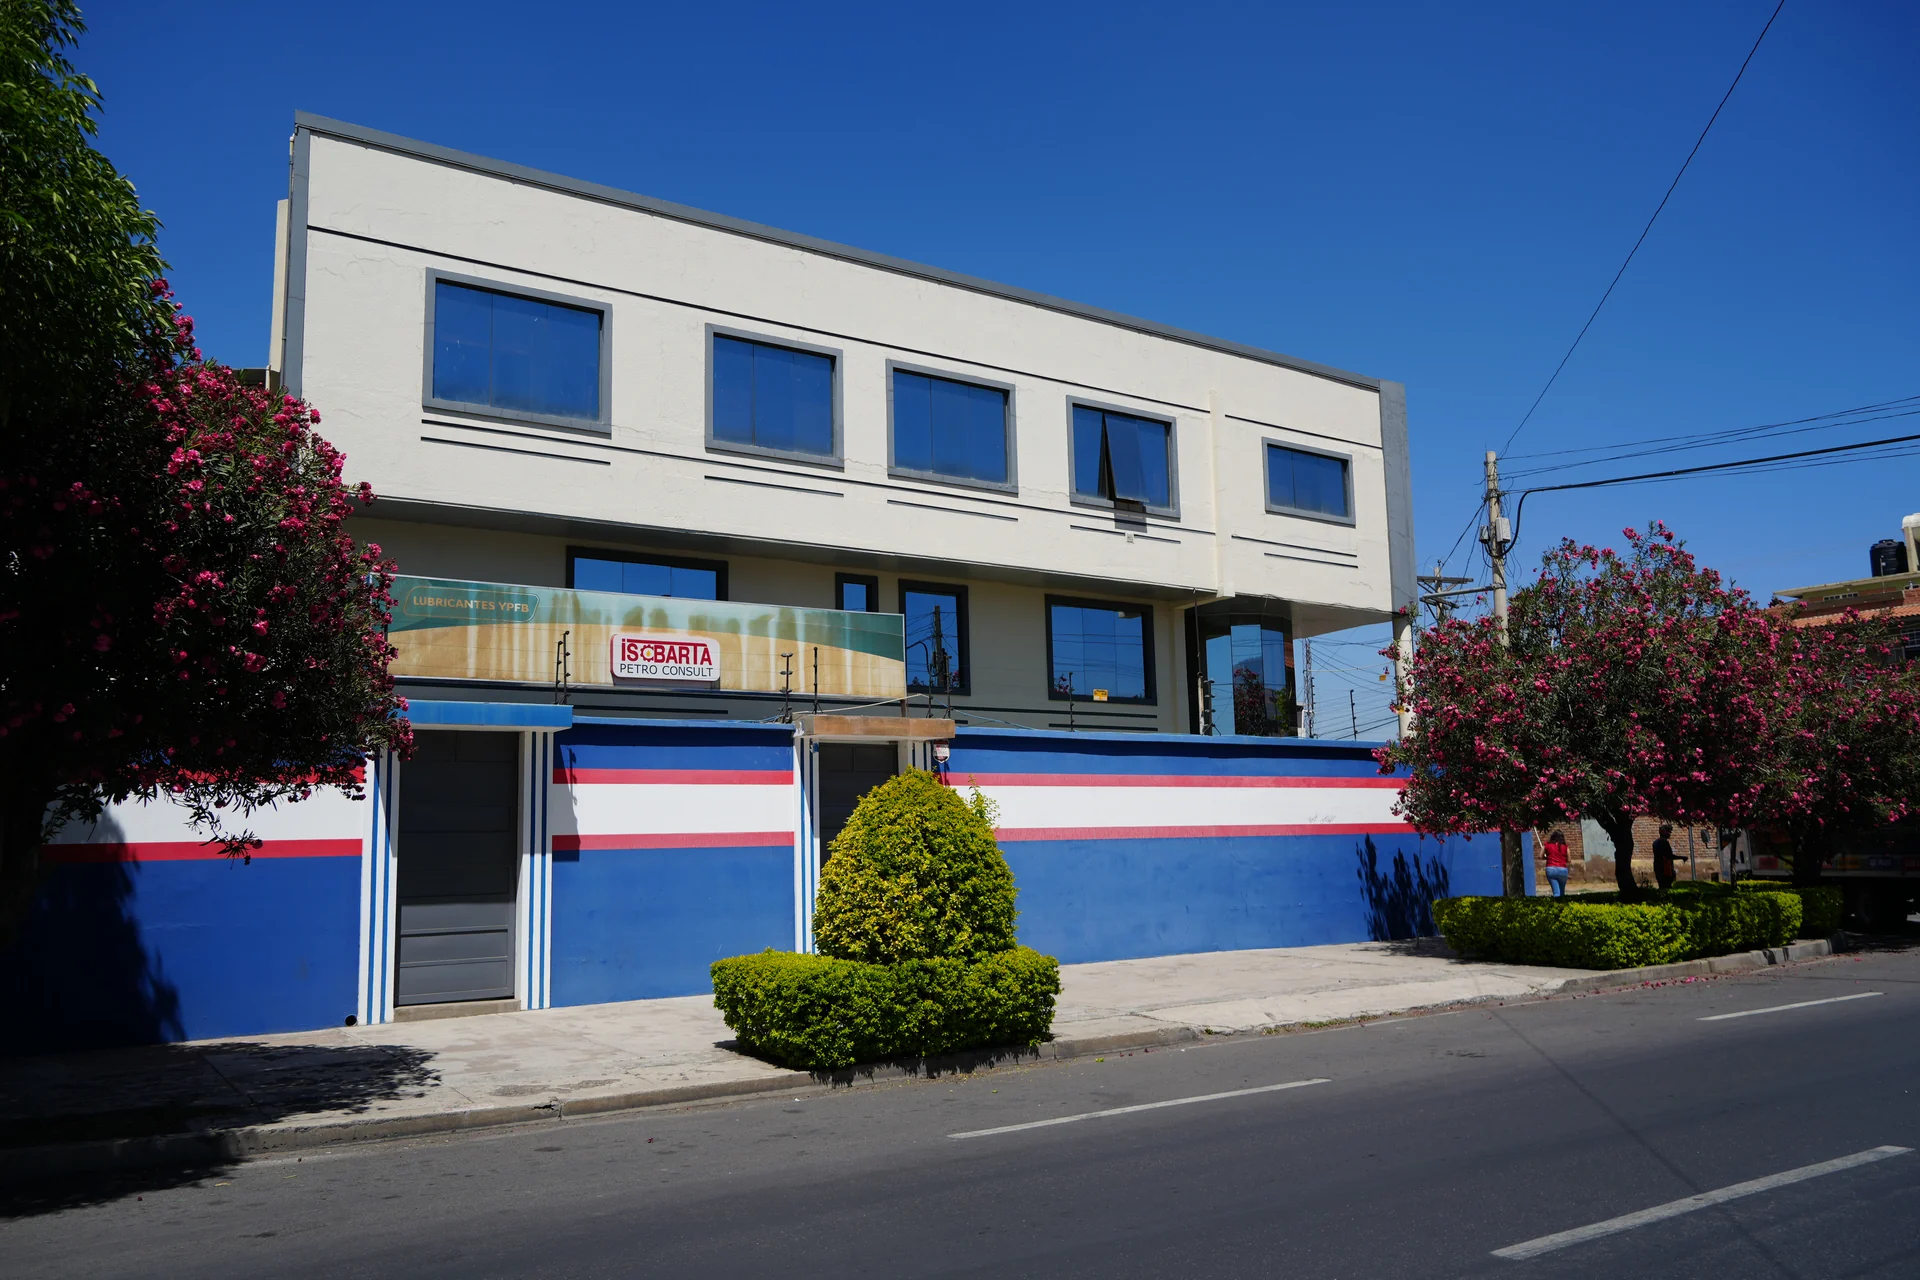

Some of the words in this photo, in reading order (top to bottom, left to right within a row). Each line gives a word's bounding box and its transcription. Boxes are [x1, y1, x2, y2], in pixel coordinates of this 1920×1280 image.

[413, 596, 495, 610] LUBRICANTES
[498, 602, 529, 613] YPFB
[620, 663, 658, 675] PETRO
[662, 665, 714, 677] CONSULT
